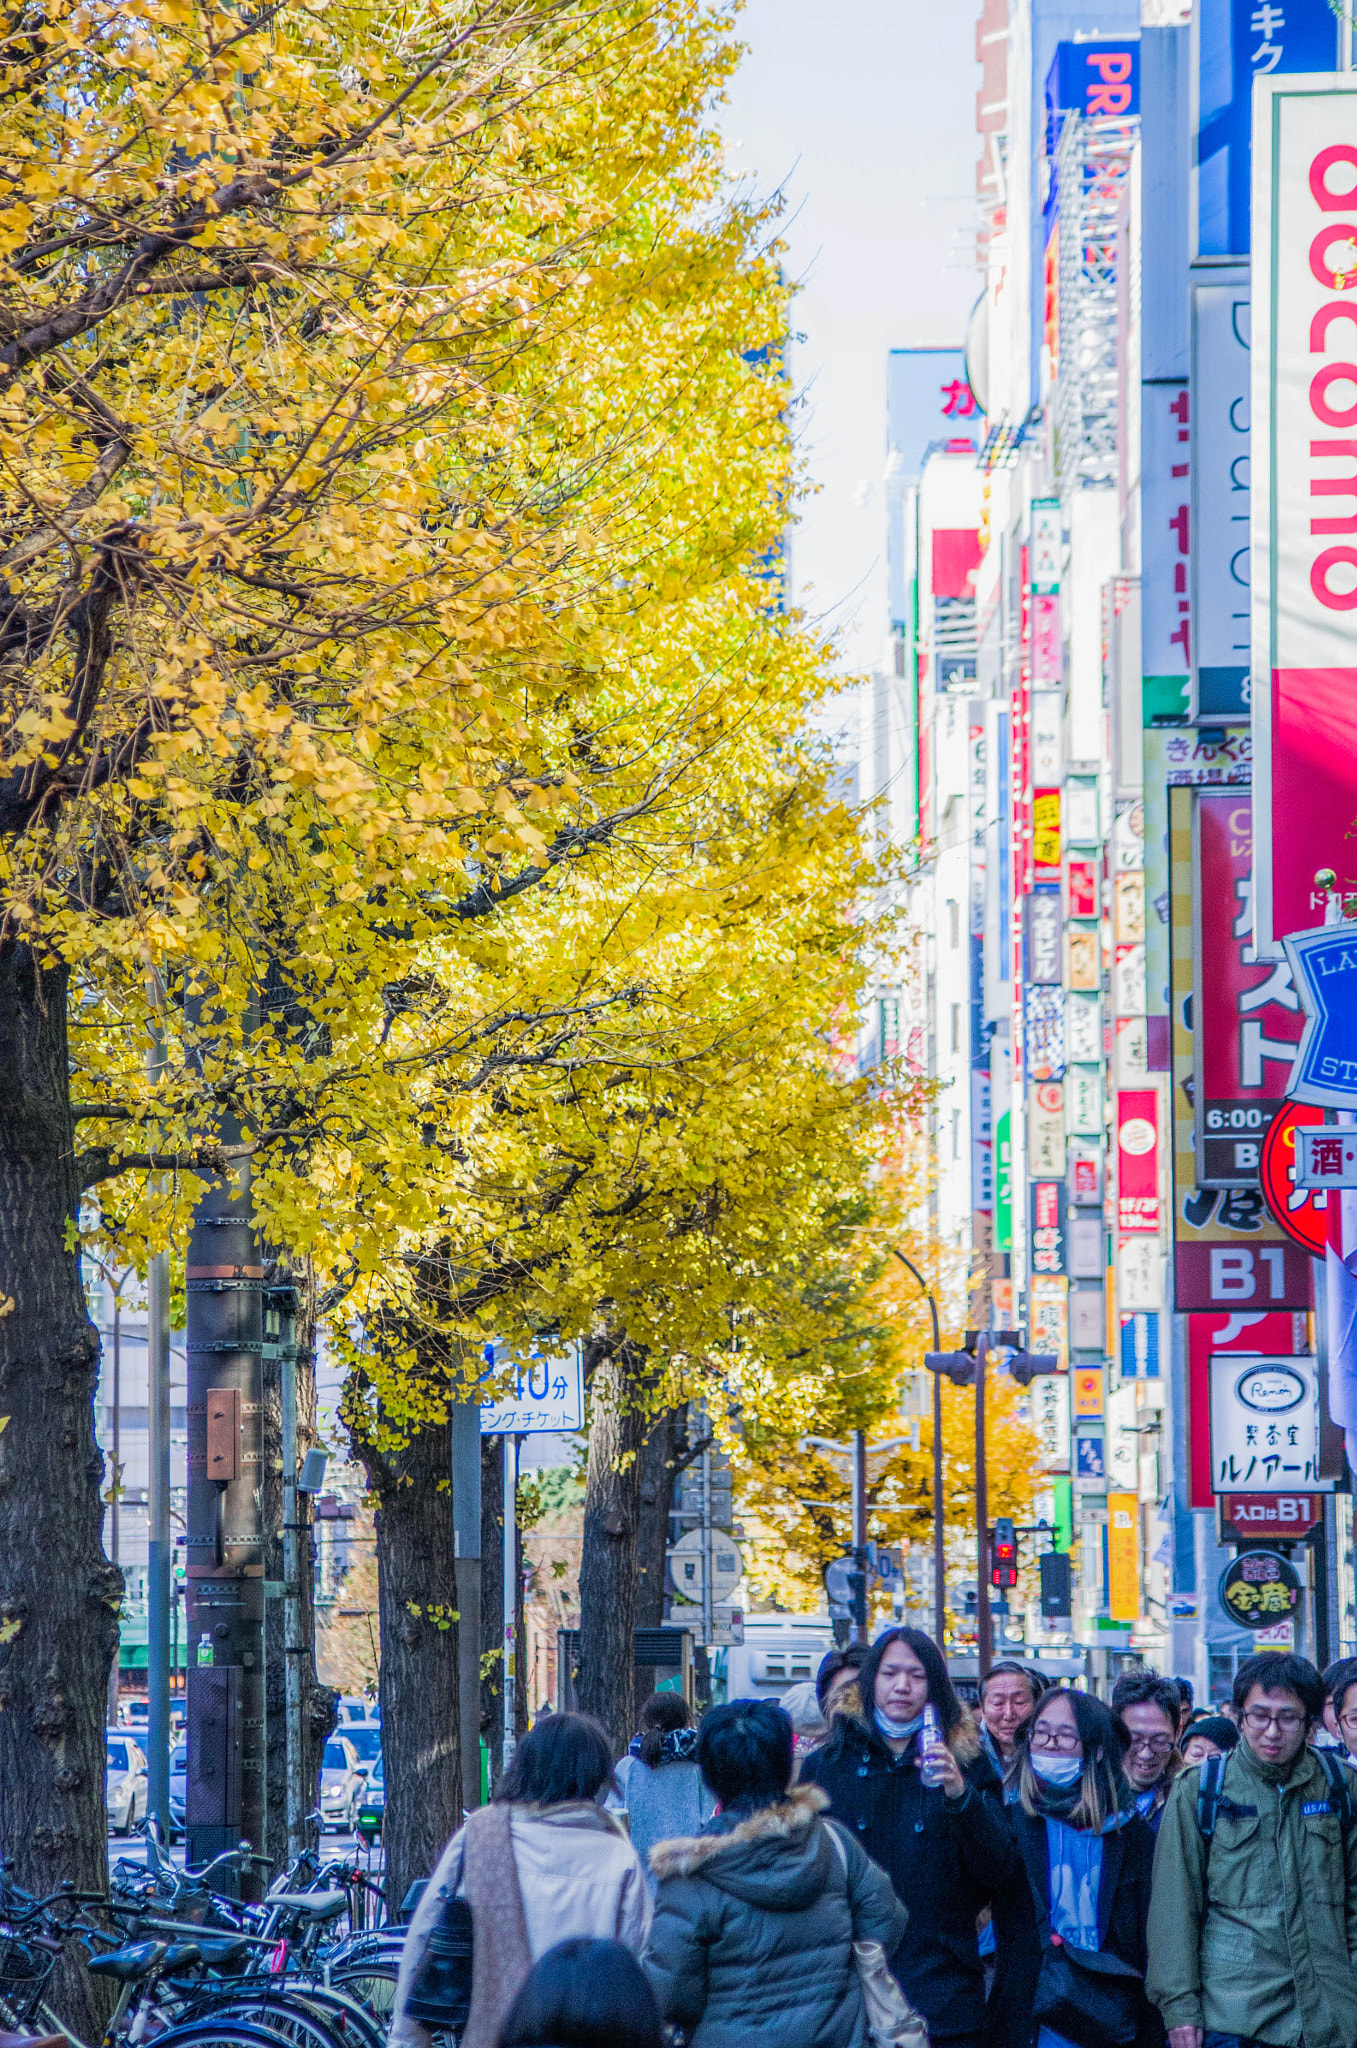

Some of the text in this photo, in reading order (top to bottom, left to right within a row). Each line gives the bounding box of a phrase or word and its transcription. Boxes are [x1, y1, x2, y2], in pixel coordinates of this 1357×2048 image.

[1250, 0, 1285, 76] キク
[1317, 950, 1357, 977] LA
[1320, 1056, 1357, 1081] ST
[1210, 1247, 1286, 1300] B1
[1220, 1454, 1320, 1483] ルノアール
